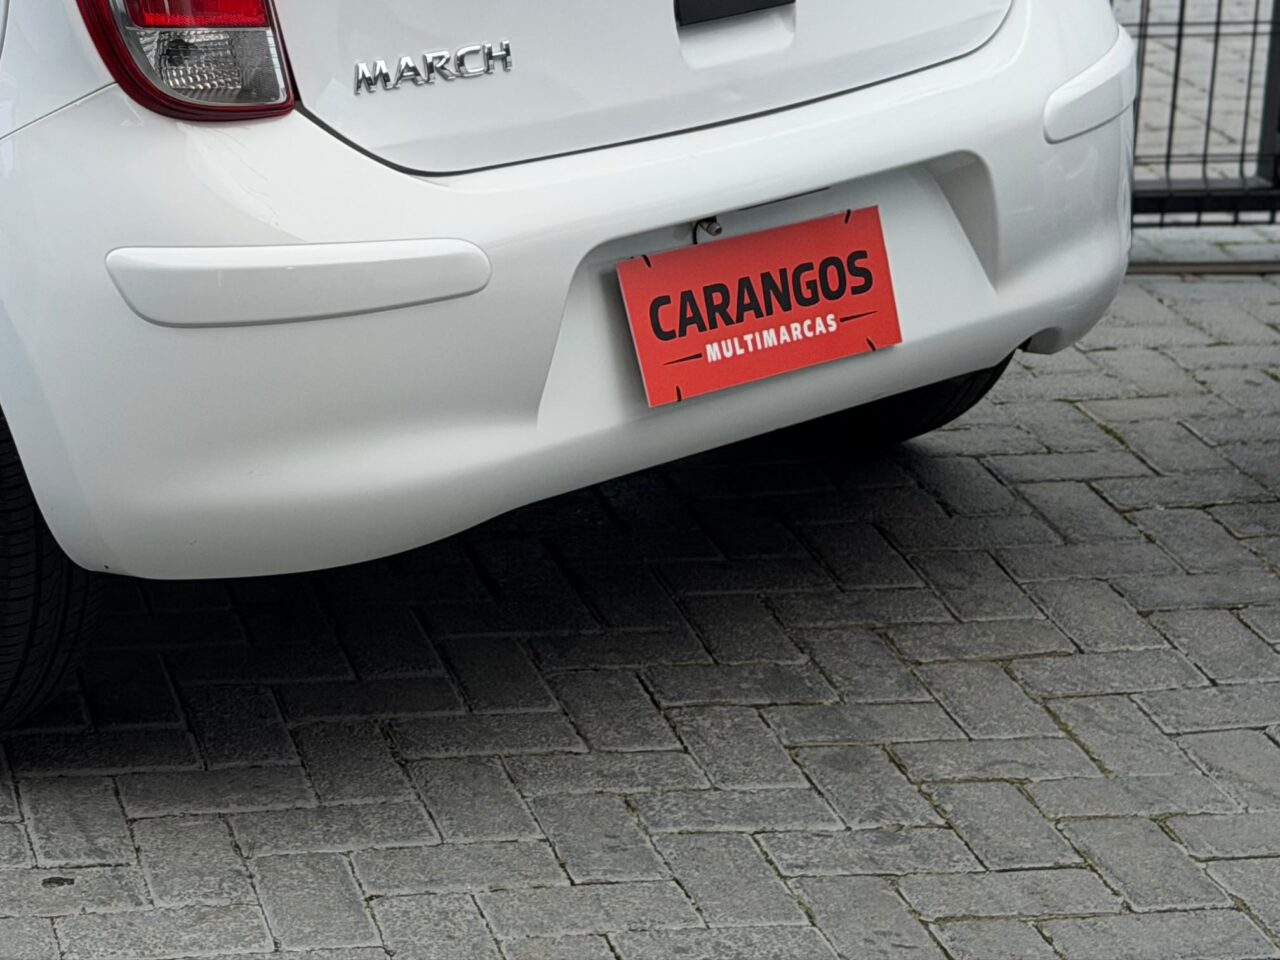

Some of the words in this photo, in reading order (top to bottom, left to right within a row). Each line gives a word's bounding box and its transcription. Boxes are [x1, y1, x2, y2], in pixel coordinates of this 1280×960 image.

[354, 40, 513, 95] MARCH
[649, 250, 873, 341] CARANGOS
[706, 313, 838, 363] MULTIMARCAS
